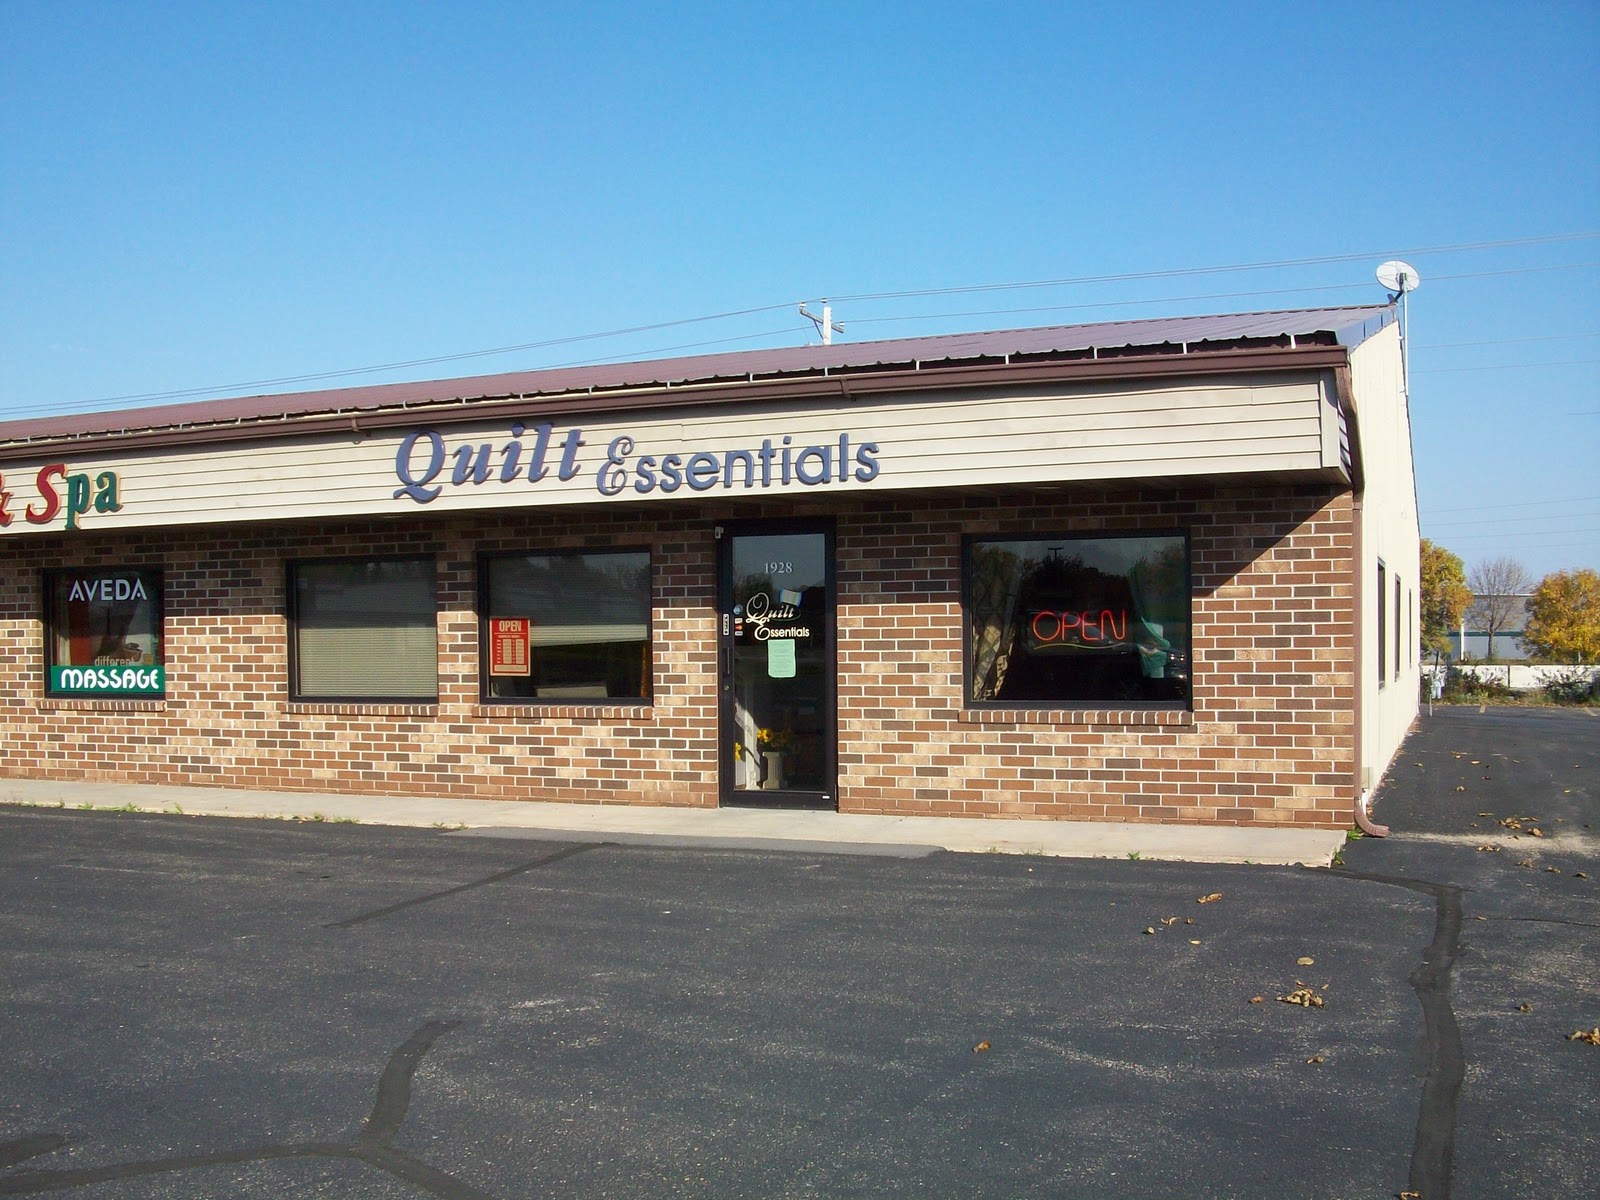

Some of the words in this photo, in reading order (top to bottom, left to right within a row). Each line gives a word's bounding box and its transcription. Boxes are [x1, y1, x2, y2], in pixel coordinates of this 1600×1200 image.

[393, 421, 586, 504] Quilt
[596, 433, 880, 496] Essentials
[25, 463, 124, 530] Spa
[764, 561, 793, 573] 1928
[69, 578, 147, 602] AVEDA
[745, 592, 796, 624] Quilt
[499, 620, 522, 632] OPEN
[754, 620, 810, 641] Essentials
[1032, 609, 1128, 641] OPEN
[94, 655, 135, 667] different
[61, 668, 159, 690] MASSAGE
